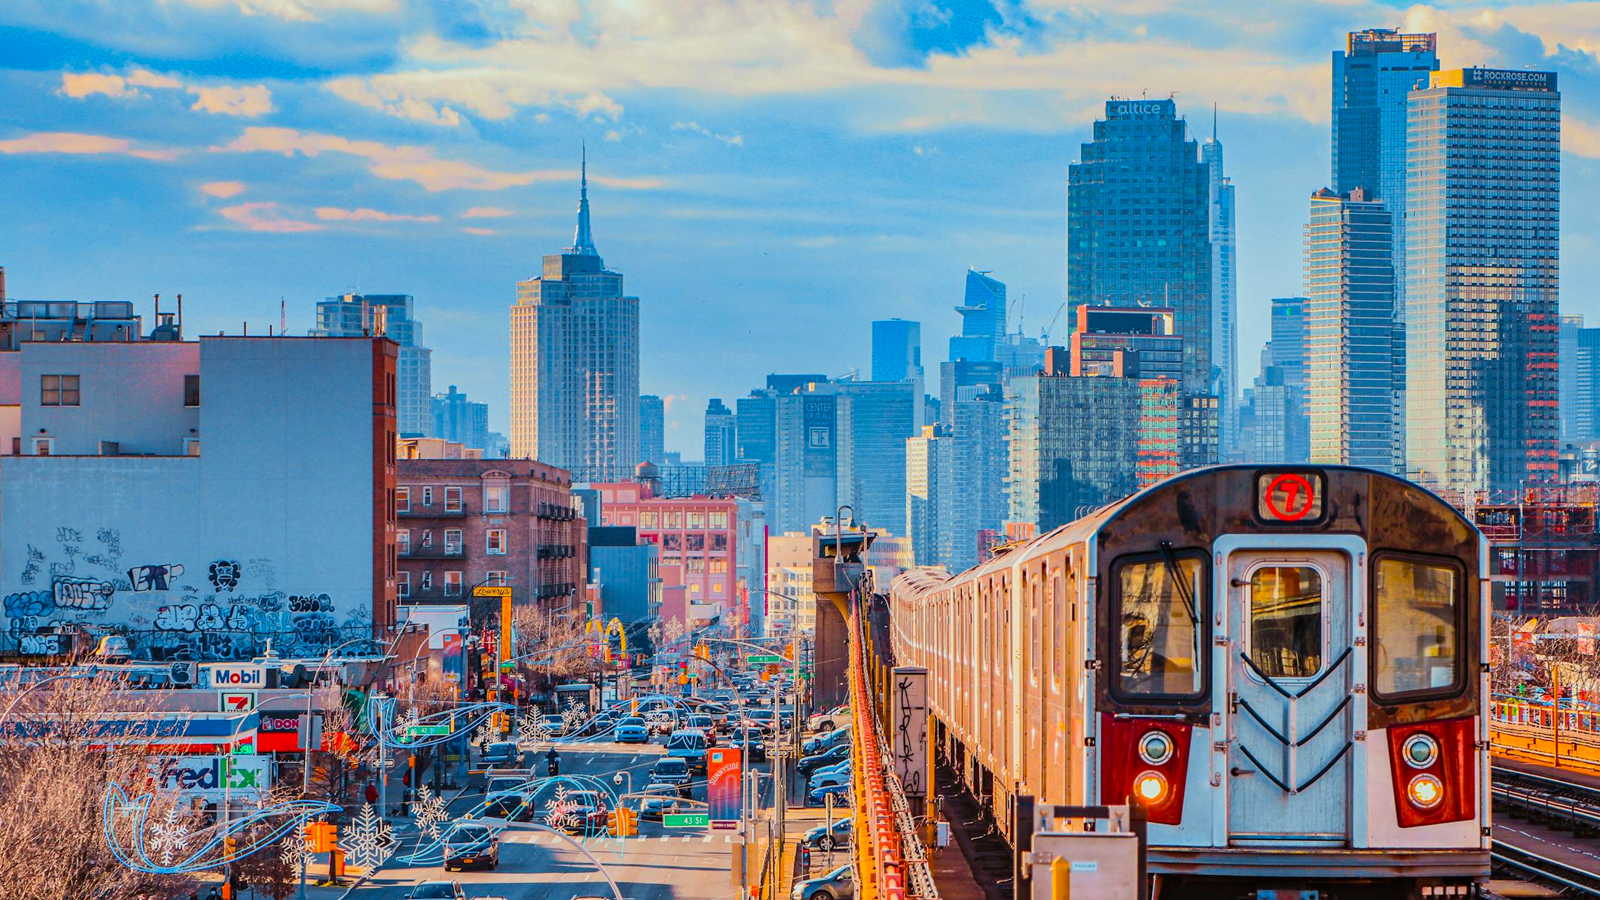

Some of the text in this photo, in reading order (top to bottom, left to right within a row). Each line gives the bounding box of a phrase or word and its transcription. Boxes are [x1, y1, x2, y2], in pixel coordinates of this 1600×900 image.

[1484, 71, 1547, 82] ROCKROSE.COM
[1118, 102, 1161, 114] altice
[806, 402, 832, 412] CENTER
[1281, 482, 1299, 512] 7
[215, 669, 260, 684] Mobil
[228, 696, 248, 709] 7
[275, 718, 299, 729] DON
[708, 761, 740, 786] SUNNYSIDE
[683, 816, 703, 825] 43 St
